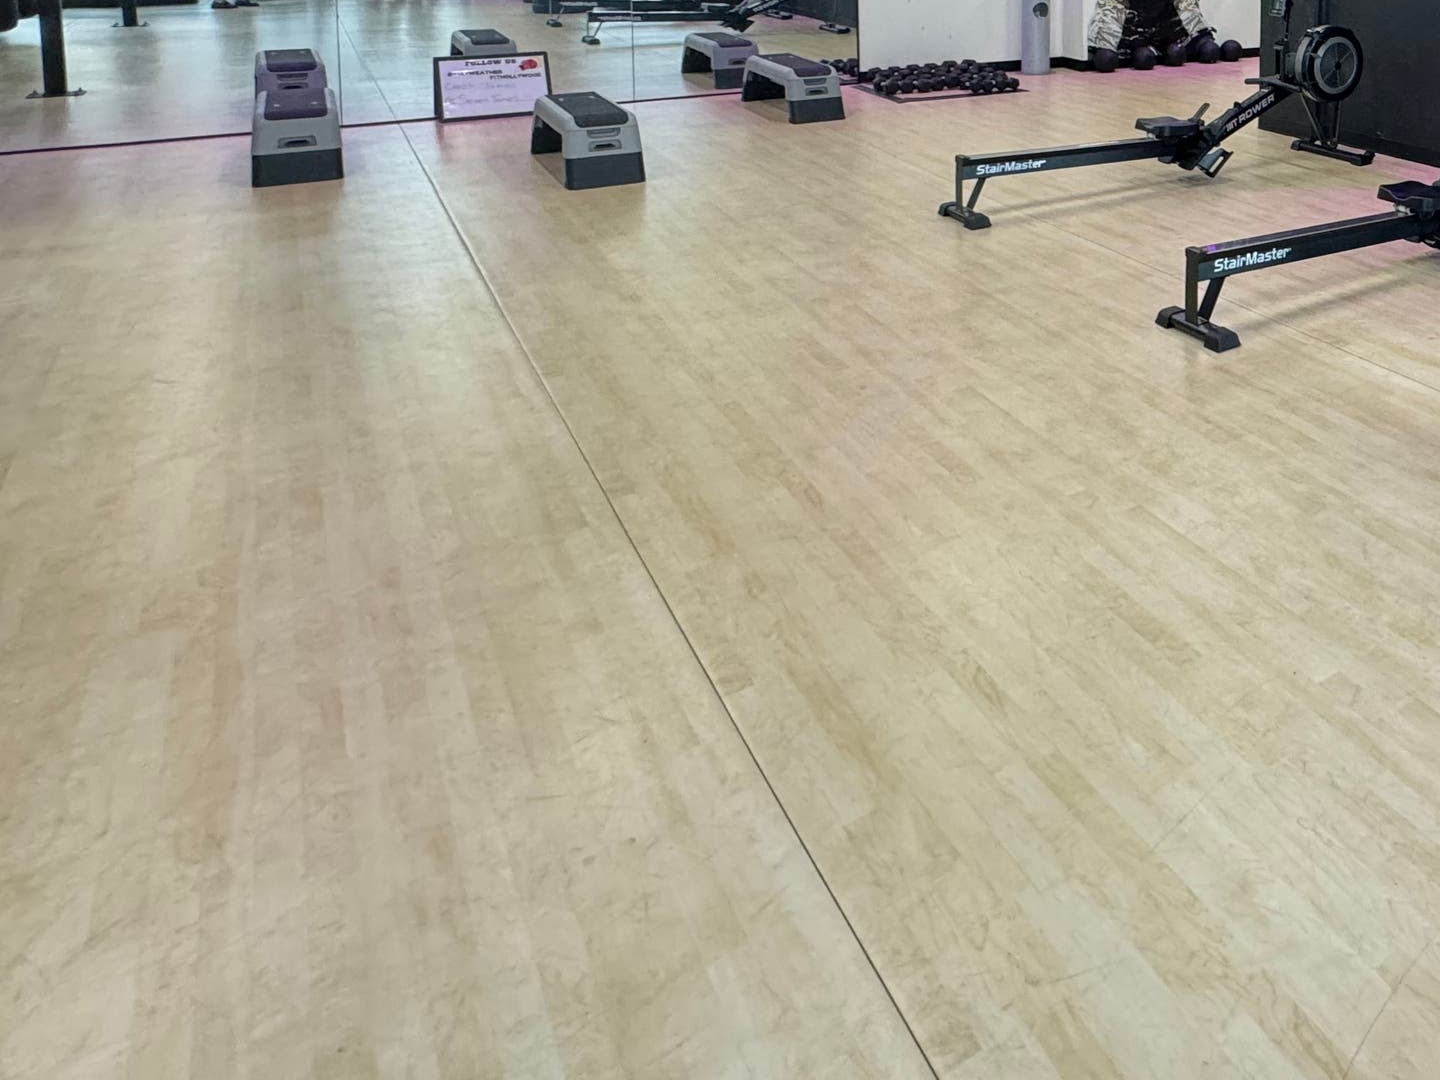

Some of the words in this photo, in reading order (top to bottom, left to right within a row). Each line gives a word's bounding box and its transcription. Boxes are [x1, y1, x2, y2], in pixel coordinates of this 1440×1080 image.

[1238, 94, 1275, 124] ROWER
[976, 159, 1047, 175] StairMaster
[1214, 248, 1292, 272] StairMaster
